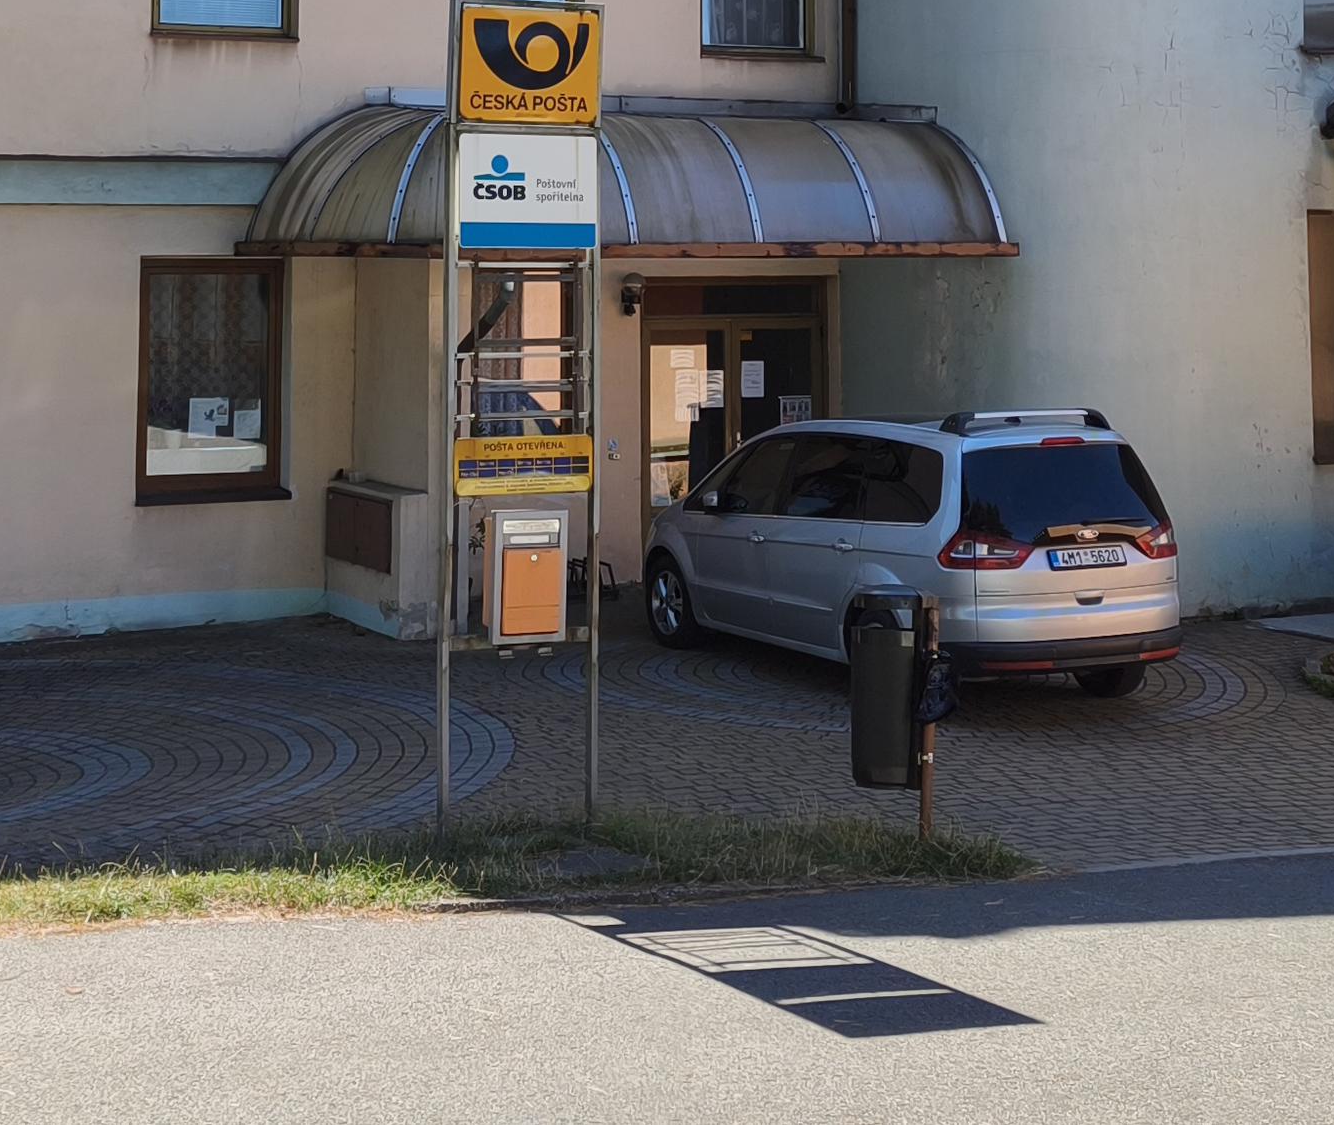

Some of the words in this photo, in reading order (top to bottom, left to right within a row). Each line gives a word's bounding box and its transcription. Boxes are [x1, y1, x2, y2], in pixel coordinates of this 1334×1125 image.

[470, 91, 528, 111] ČESKÁ
[532, 93, 588, 112] POŠTA
[473, 182, 526, 200] ČSOB
[536, 178, 577, 190] Poštovní
[536, 191, 584, 203] spořitelna
[483, 441, 514, 452] POŠTA
[1062, 551, 1083, 565] 4M1
[1090, 549, 1120, 563] 5620
